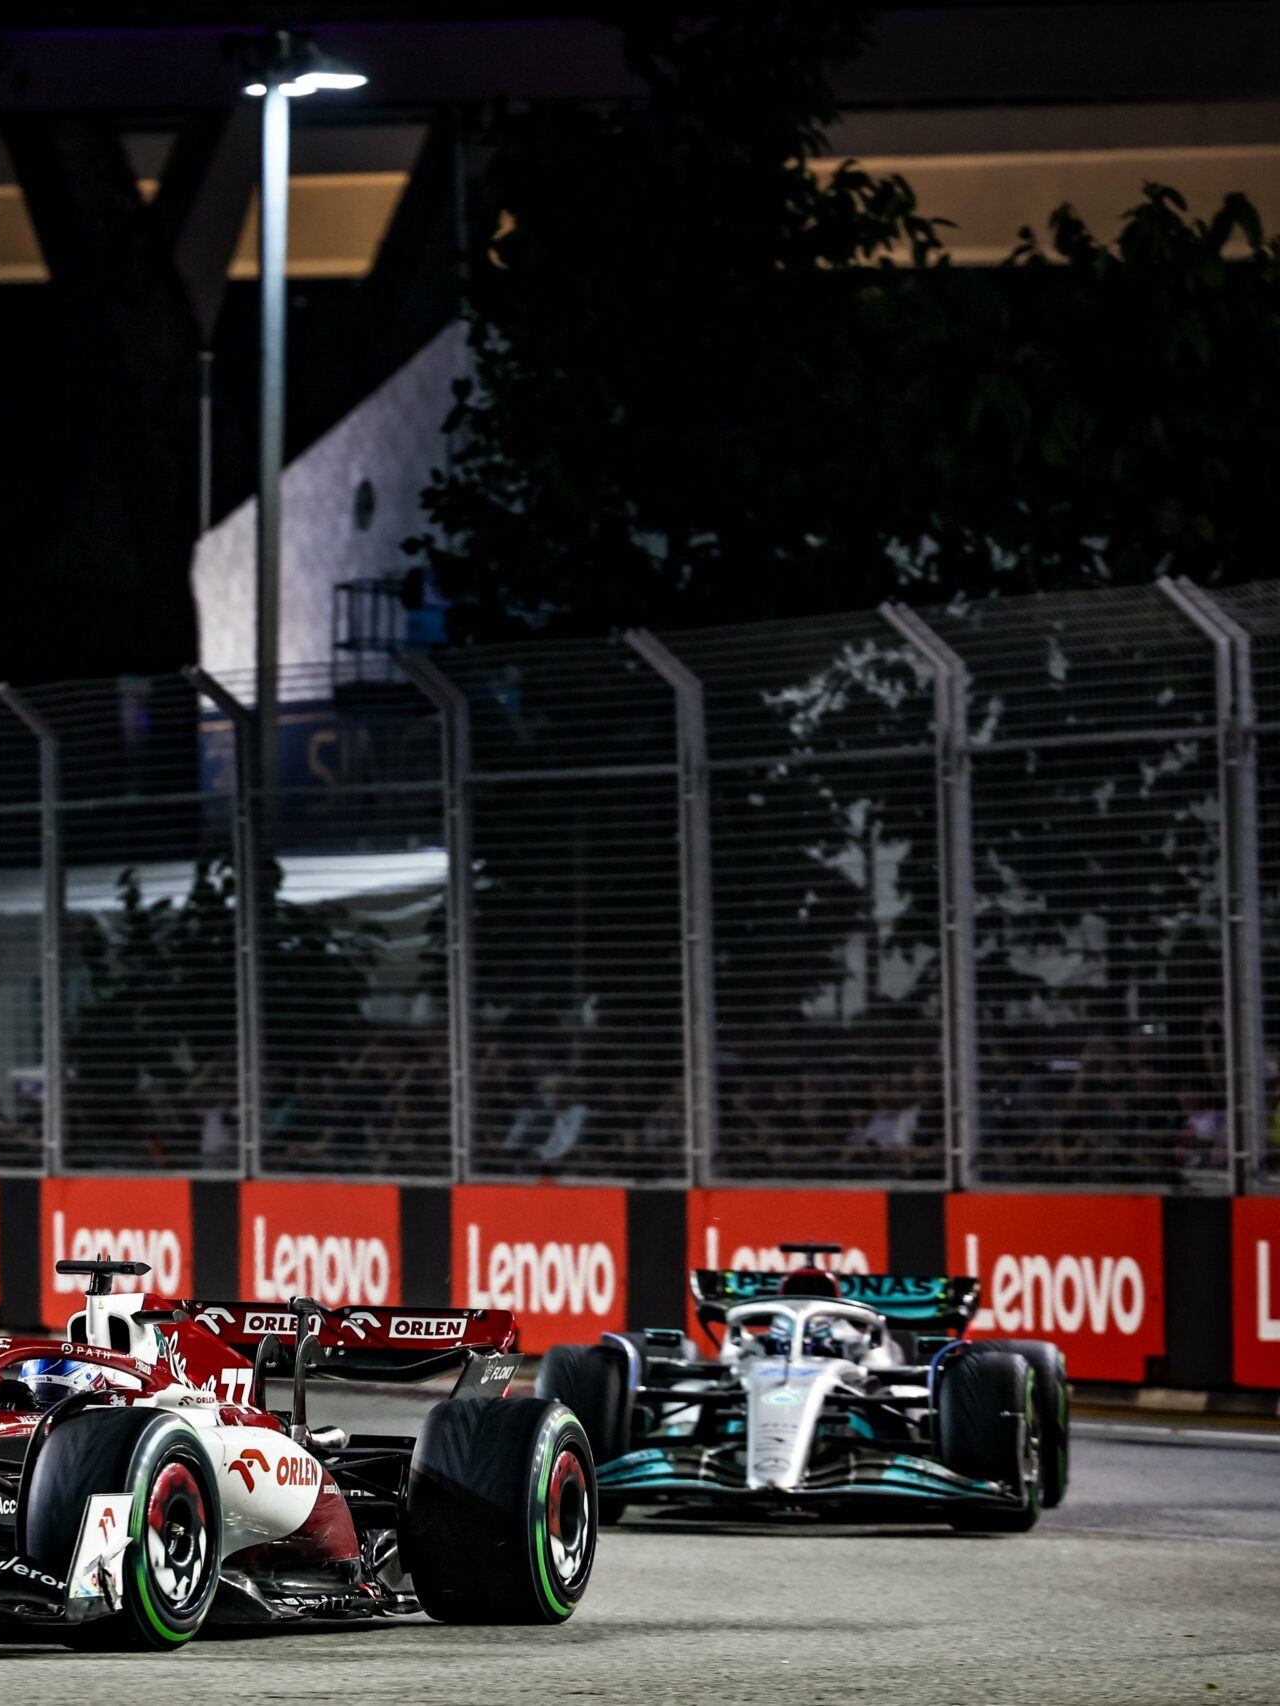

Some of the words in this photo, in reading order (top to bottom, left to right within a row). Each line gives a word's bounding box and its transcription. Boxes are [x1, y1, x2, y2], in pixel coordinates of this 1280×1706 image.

[253, 1216, 391, 1304] Lenovo
[467, 1224, 616, 1316] Lenovo
[966, 1234, 1145, 1335] Lenovo
[395, 1319, 462, 1336] ORLEN
[76, 1346, 111, 1360] PATH
[220, 1368, 262, 1414] 77
[490, 1366, 514, 1380] FLOKI
[276, 1456, 318, 1486] ORLEN
